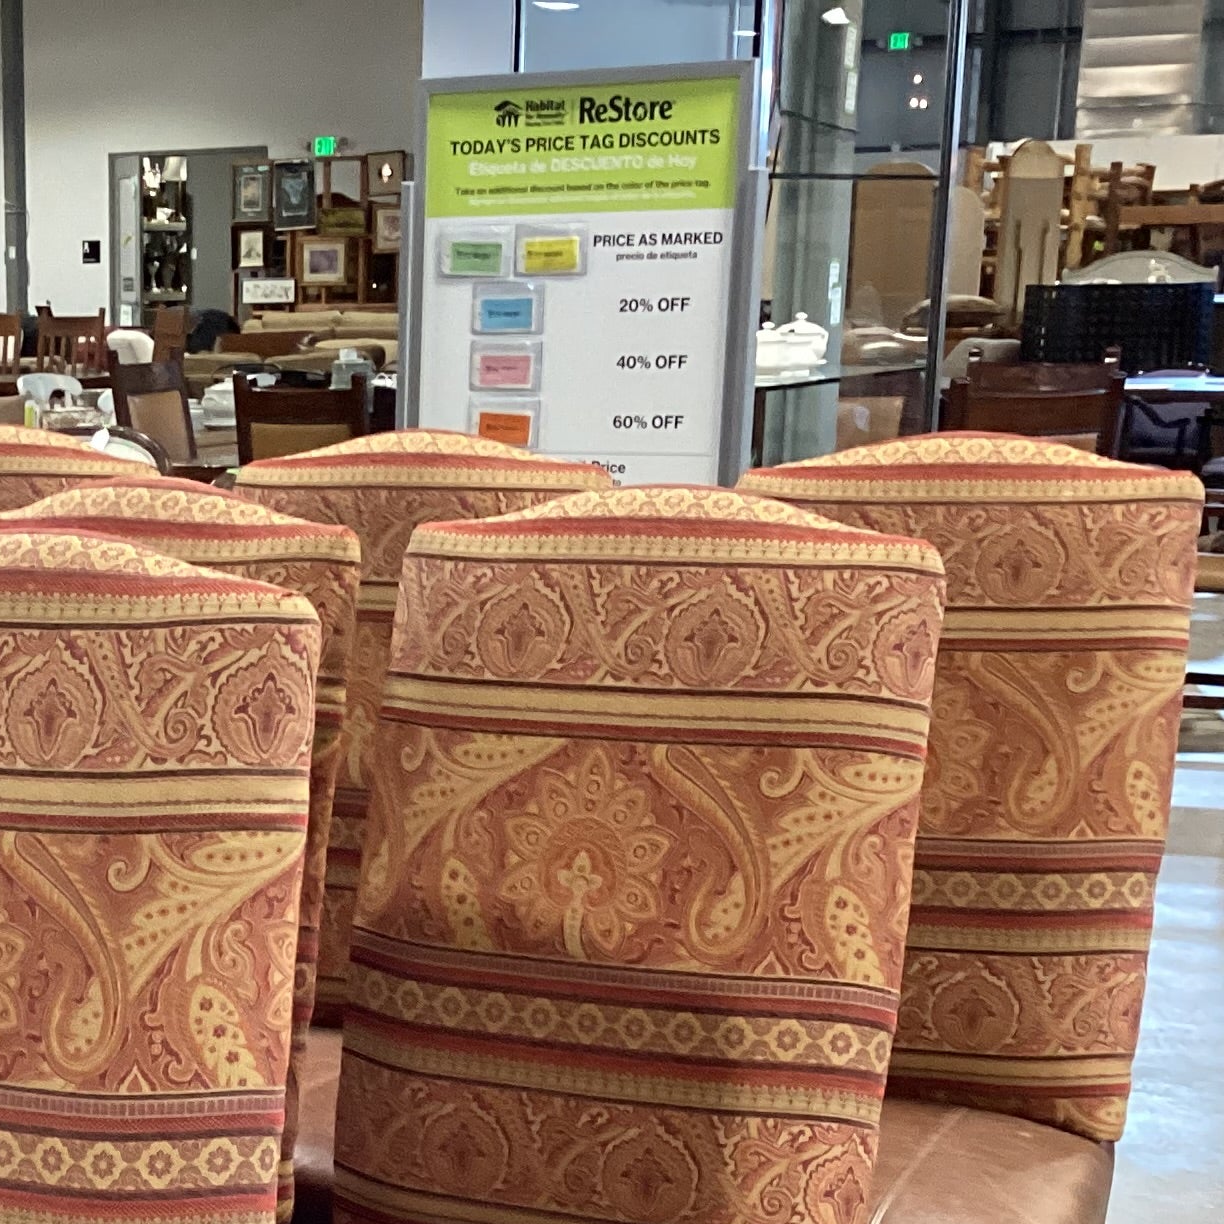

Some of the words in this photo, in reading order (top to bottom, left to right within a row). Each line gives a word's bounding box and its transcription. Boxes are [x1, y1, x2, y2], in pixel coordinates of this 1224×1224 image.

[579, 94, 672, 125] ReStore
[450, 137, 521, 156] TODAY'S
[526, 135, 575, 152] PRICE
[579, 133, 614, 150] TAG
[619, 128, 721, 149] DISCOUNTS
[551, 153, 644, 173] DESCUENTO
[593, 234, 635, 247] PRICE
[638, 233, 658, 246] AS
[661, 231, 724, 246] MARKED
[616, 251, 645, 262] precio
[646, 251, 658, 260] de
[659, 250, 698, 261] etiqueta
[619, 298, 654, 313] 20%
[657, 297, 691, 312] OFF
[616, 355, 651, 370] 40%
[655, 354, 688, 370] OFF
[612, 415, 648, 430] 60%
[651, 415, 685, 430] OFF
